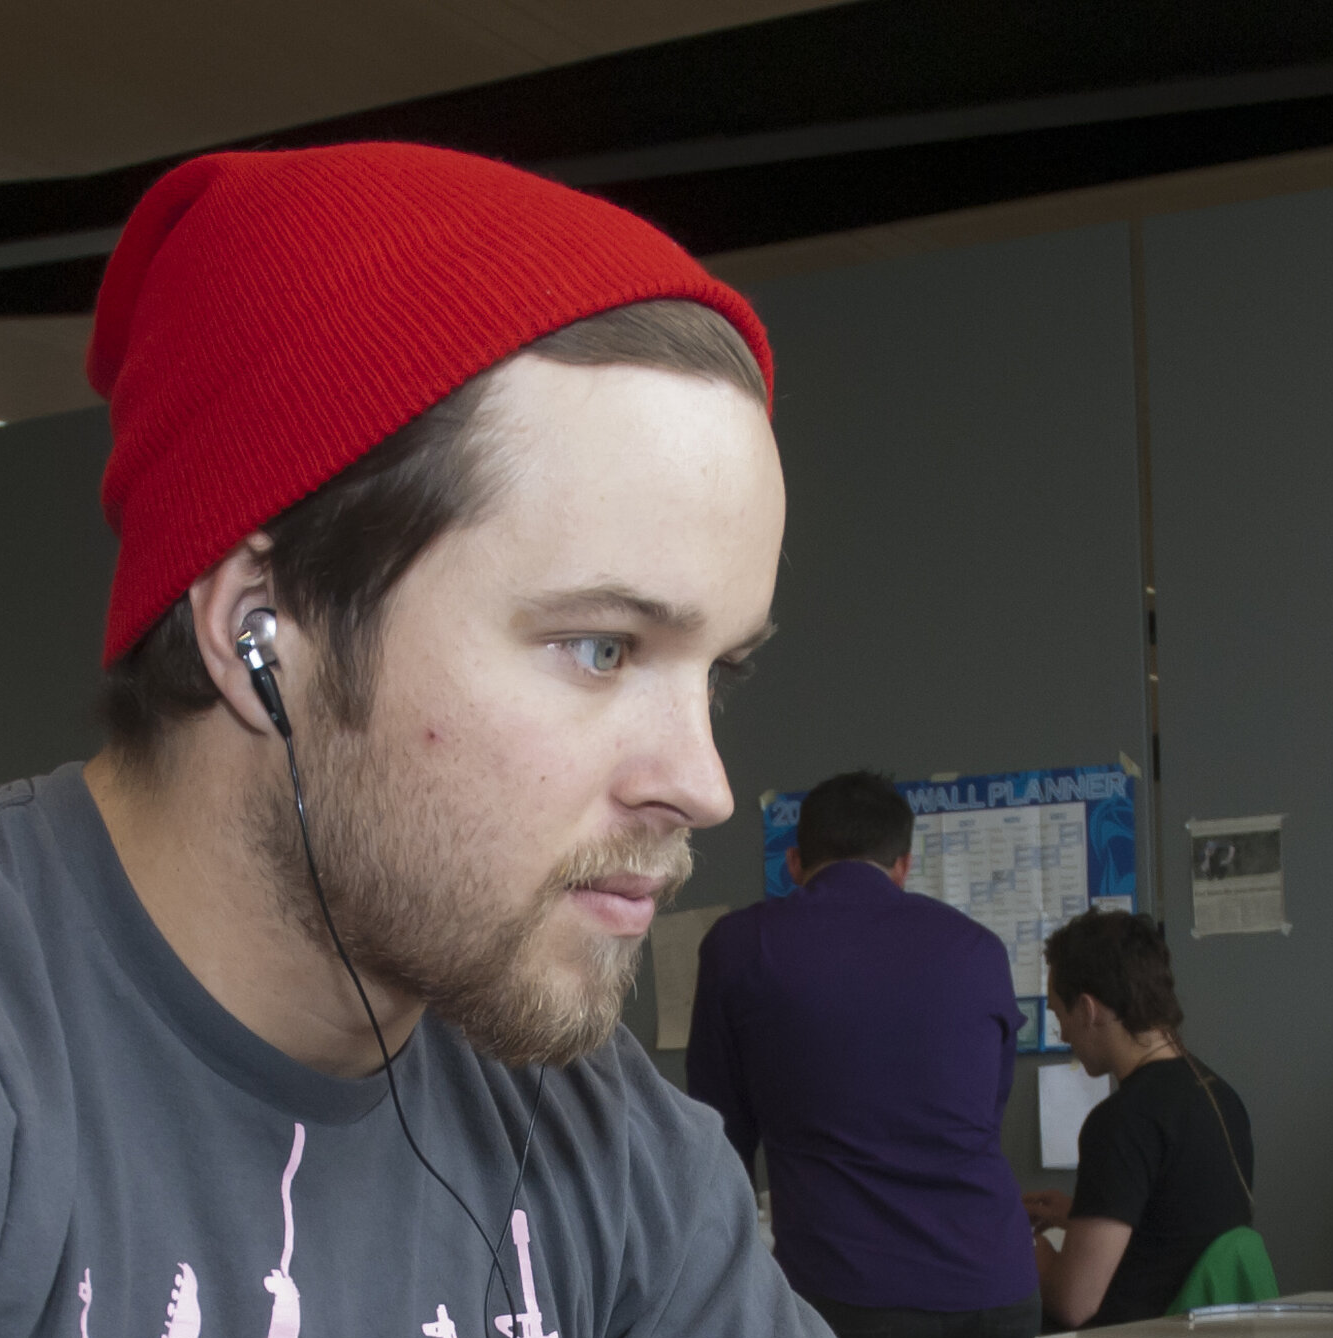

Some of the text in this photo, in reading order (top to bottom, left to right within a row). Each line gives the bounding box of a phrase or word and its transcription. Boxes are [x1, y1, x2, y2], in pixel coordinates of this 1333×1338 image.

[772, 772, 1127, 826] 20 WALL PLANNER
